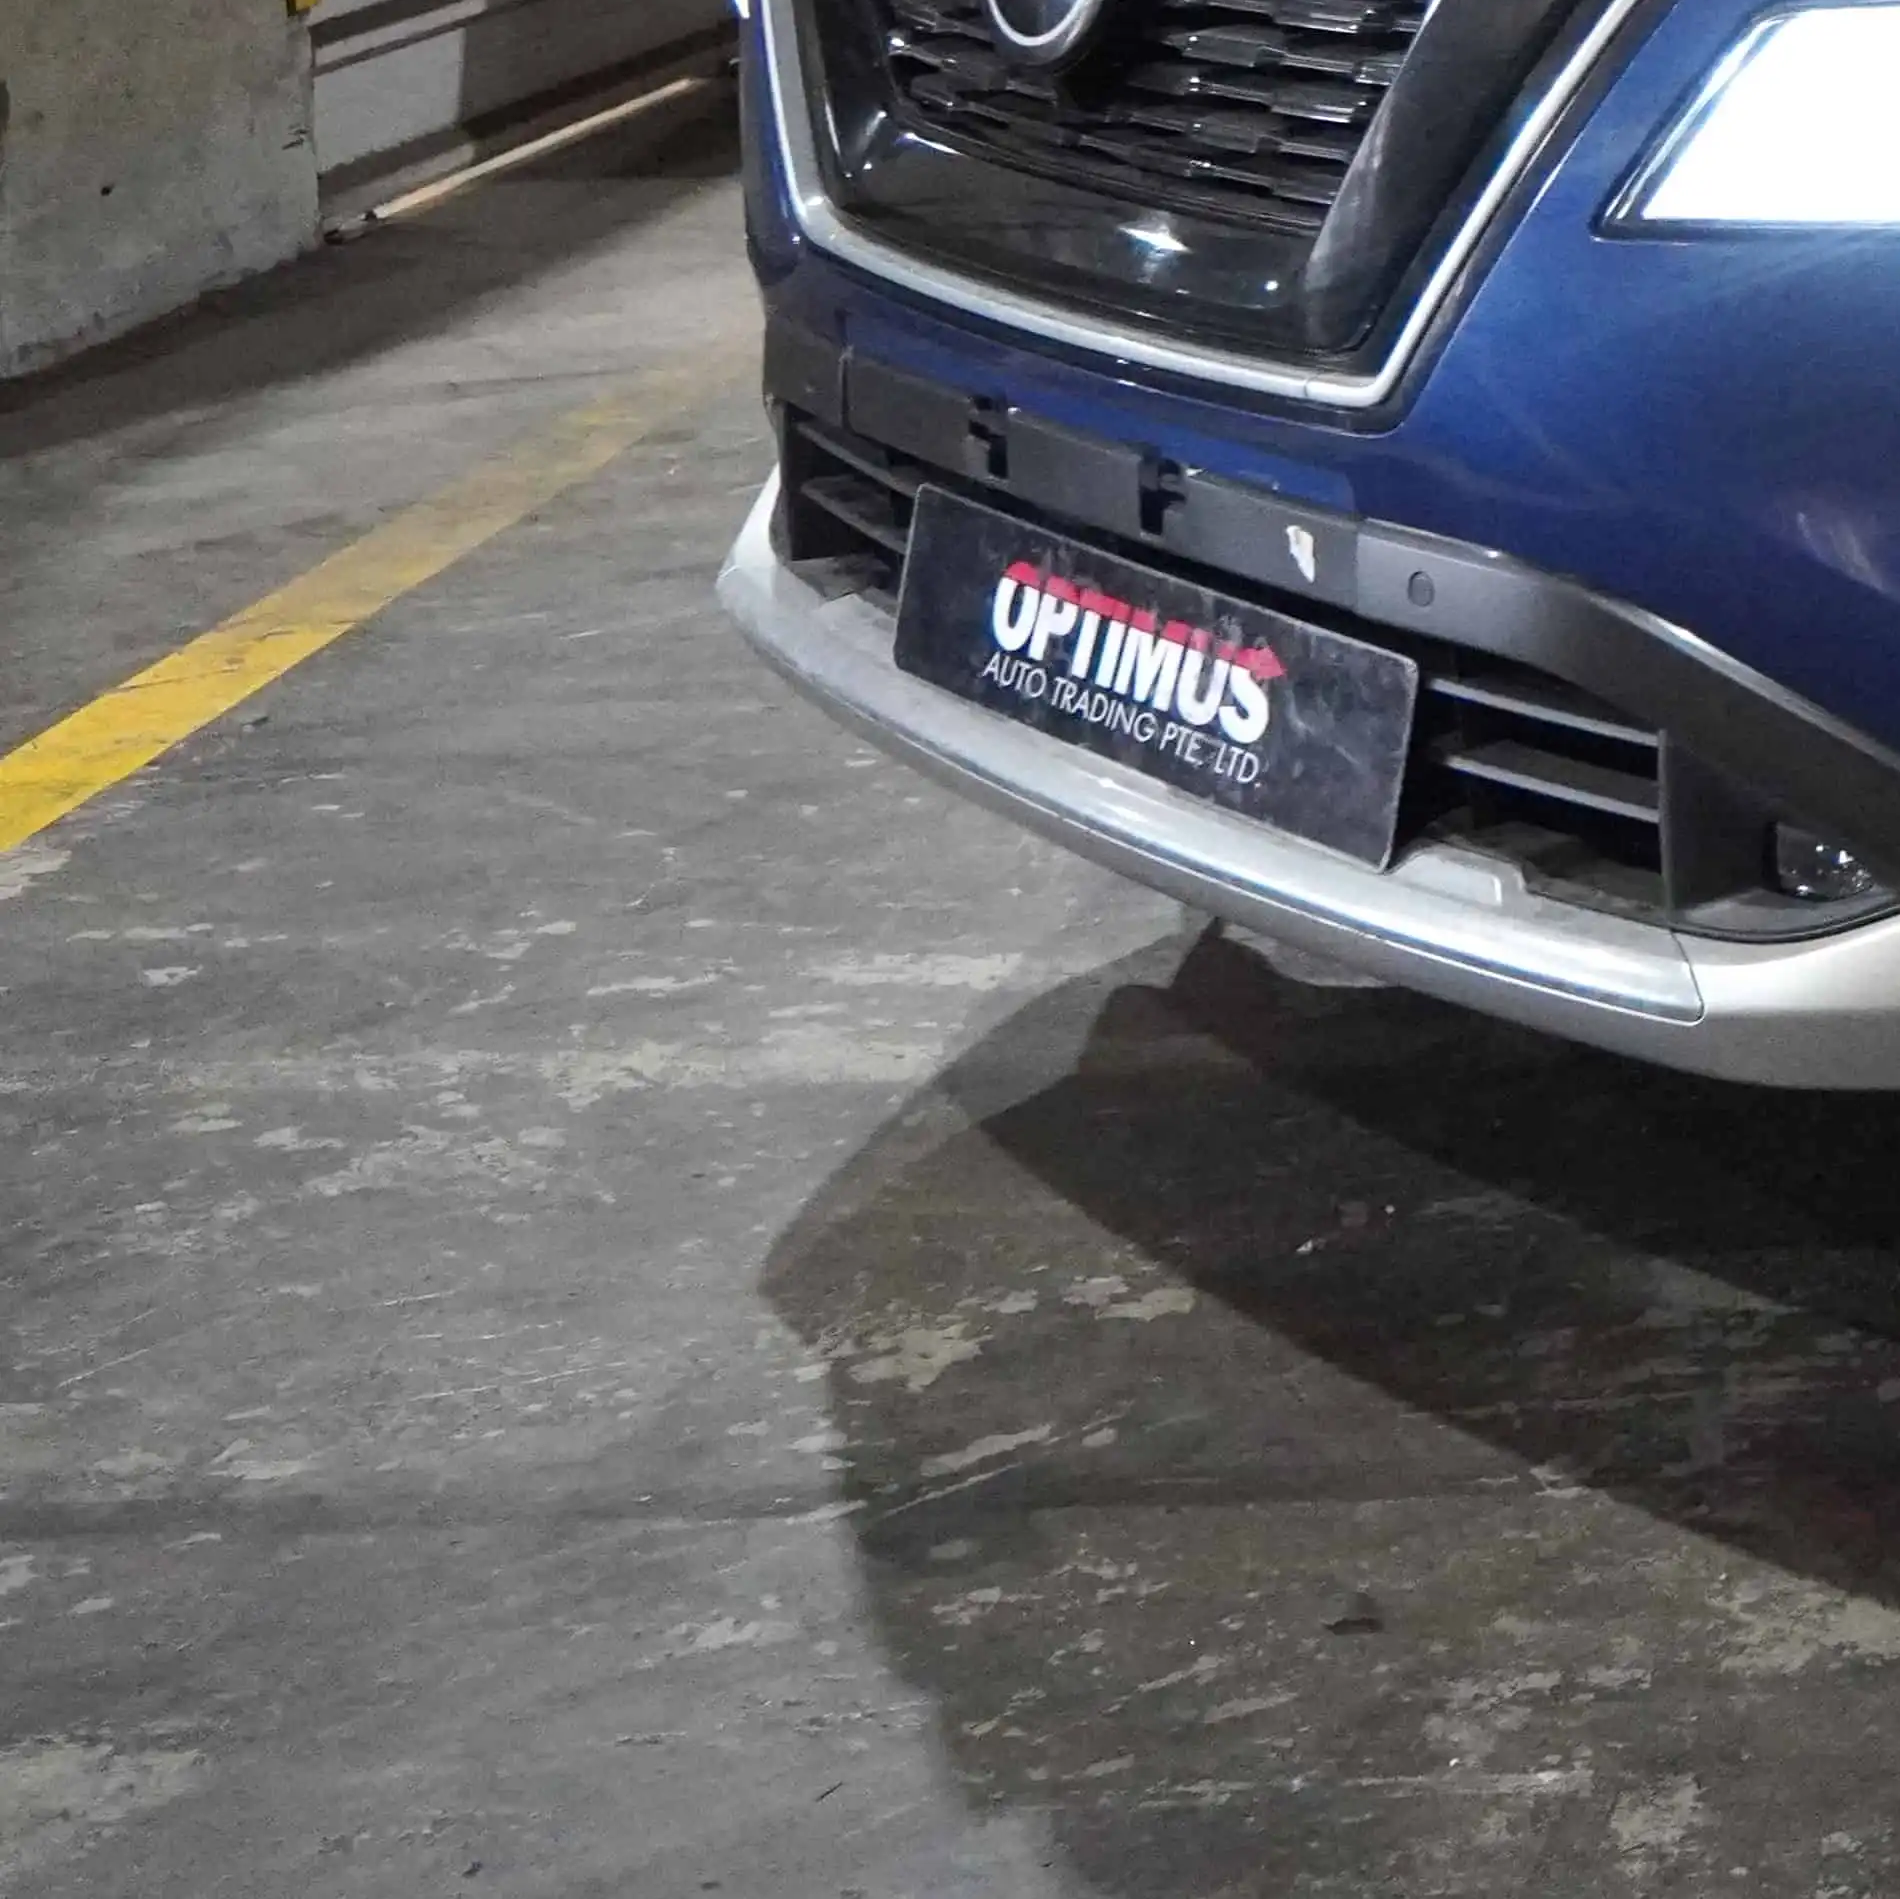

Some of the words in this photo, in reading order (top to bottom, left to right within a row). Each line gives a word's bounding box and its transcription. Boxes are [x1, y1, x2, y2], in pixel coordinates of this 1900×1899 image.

[982, 652, 1047, 698] AUTO
[1051, 677, 1156, 743] TRADING
[992, 561, 1276, 743] OPTIMUS
